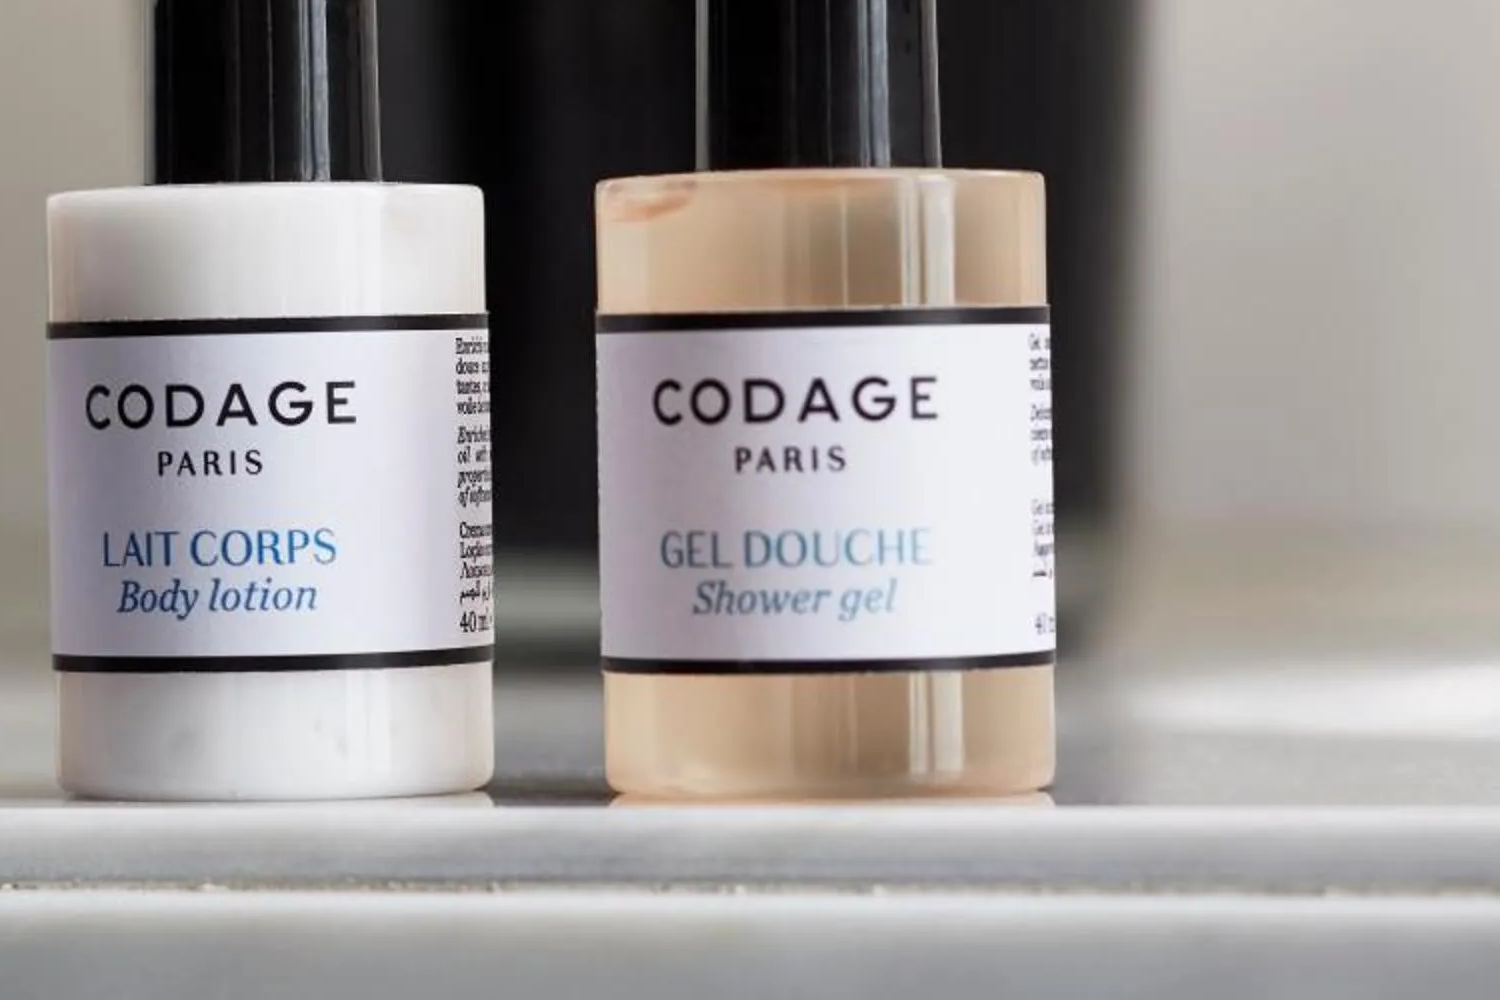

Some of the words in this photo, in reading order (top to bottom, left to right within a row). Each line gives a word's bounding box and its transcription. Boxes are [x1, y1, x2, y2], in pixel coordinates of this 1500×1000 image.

[87, 381, 357, 431] CODAGE
[653, 376, 939, 427] CODAGE
[159, 450, 264, 478] PARIS
[735, 446, 847, 474] PARIS
[104, 532, 179, 568] LAIT
[191, 529, 337, 568] CORPS
[661, 531, 731, 570] GEL
[744, 526, 934, 569] DOUCHE
[117, 579, 200, 622] Body
[209, 578, 318, 613] lotion
[692, 581, 832, 617] Shower
[838, 578, 899, 624] gel
